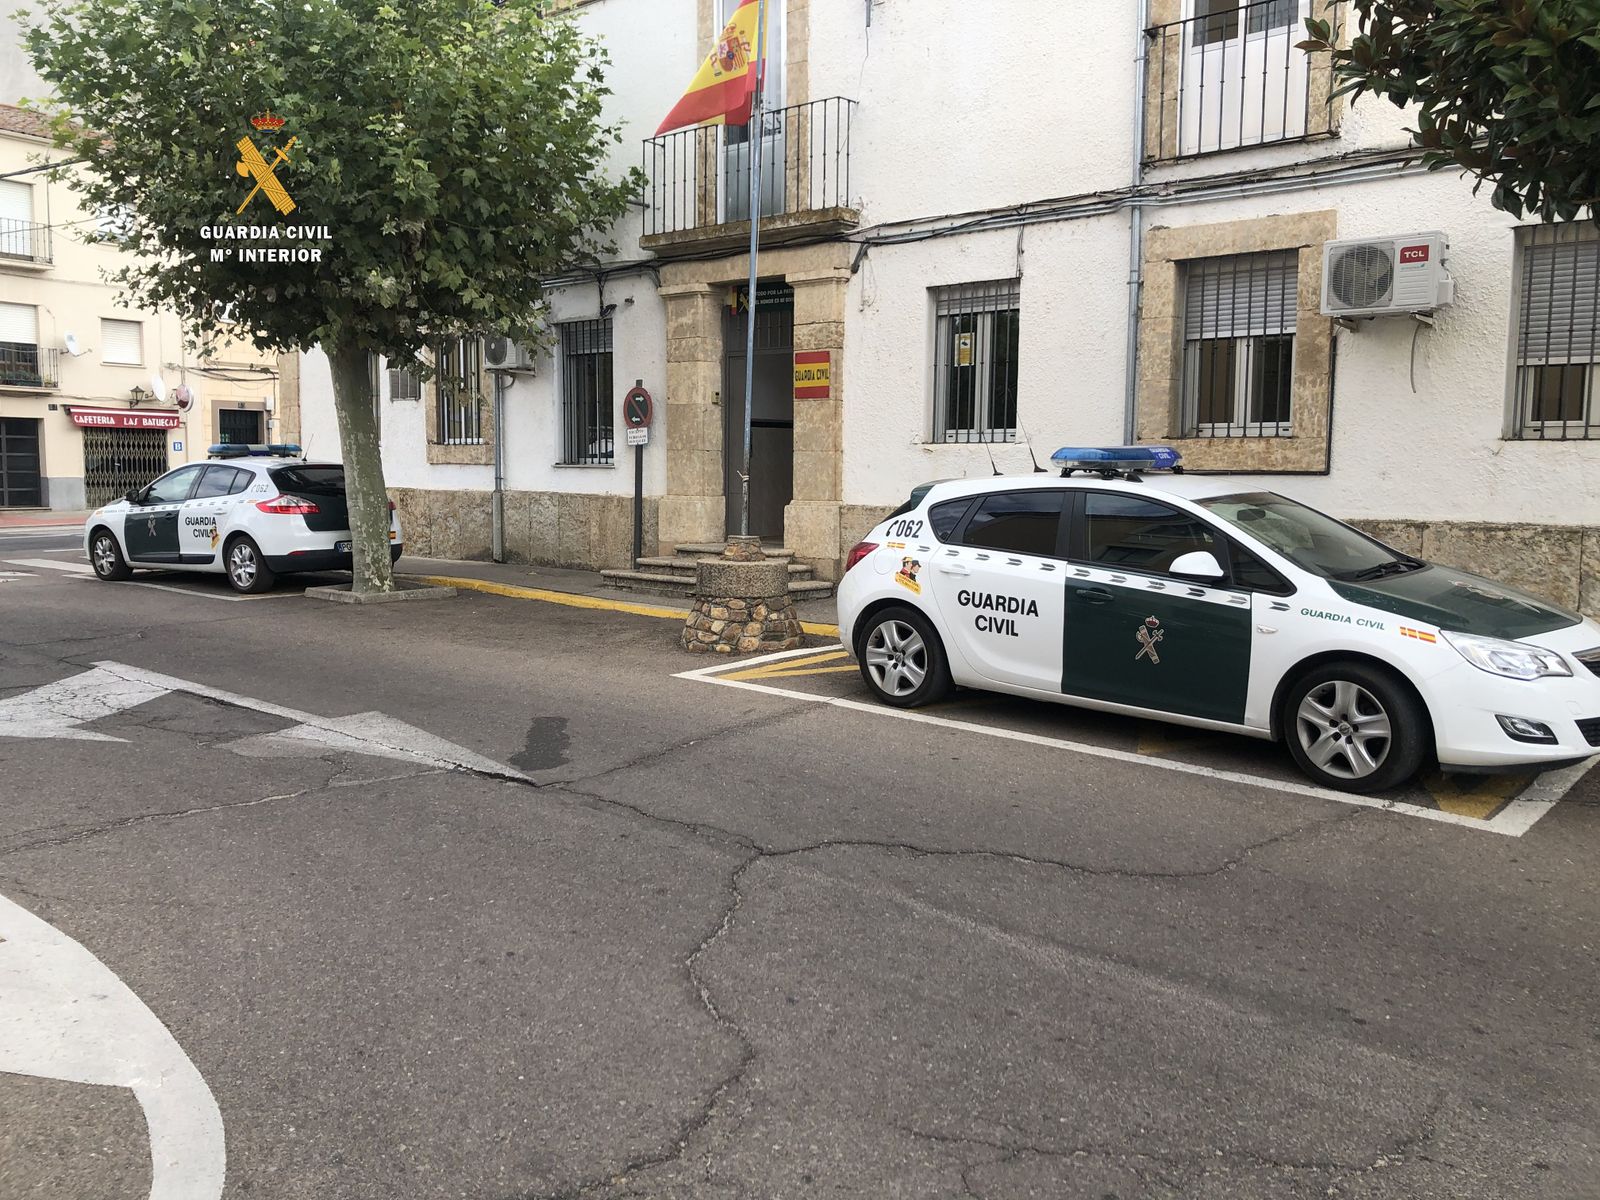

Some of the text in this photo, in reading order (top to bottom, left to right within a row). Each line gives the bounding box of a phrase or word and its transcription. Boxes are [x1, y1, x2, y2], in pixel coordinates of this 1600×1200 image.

[1404, 250, 1425, 258] TCL
[795, 368, 829, 381] GUARDIA CIVIL
[73, 415, 178, 427] CAFETERIA LAS BATUECAS
[185, 516, 217, 526] GUARDIA
[192, 528, 211, 538] CIVIL
[895, 519, 924, 539] 062
[957, 589, 1039, 617] GUARDIA
[974, 614, 1019, 637] CIVIL
[1300, 607, 1385, 631] GUARDIA CIVIL
